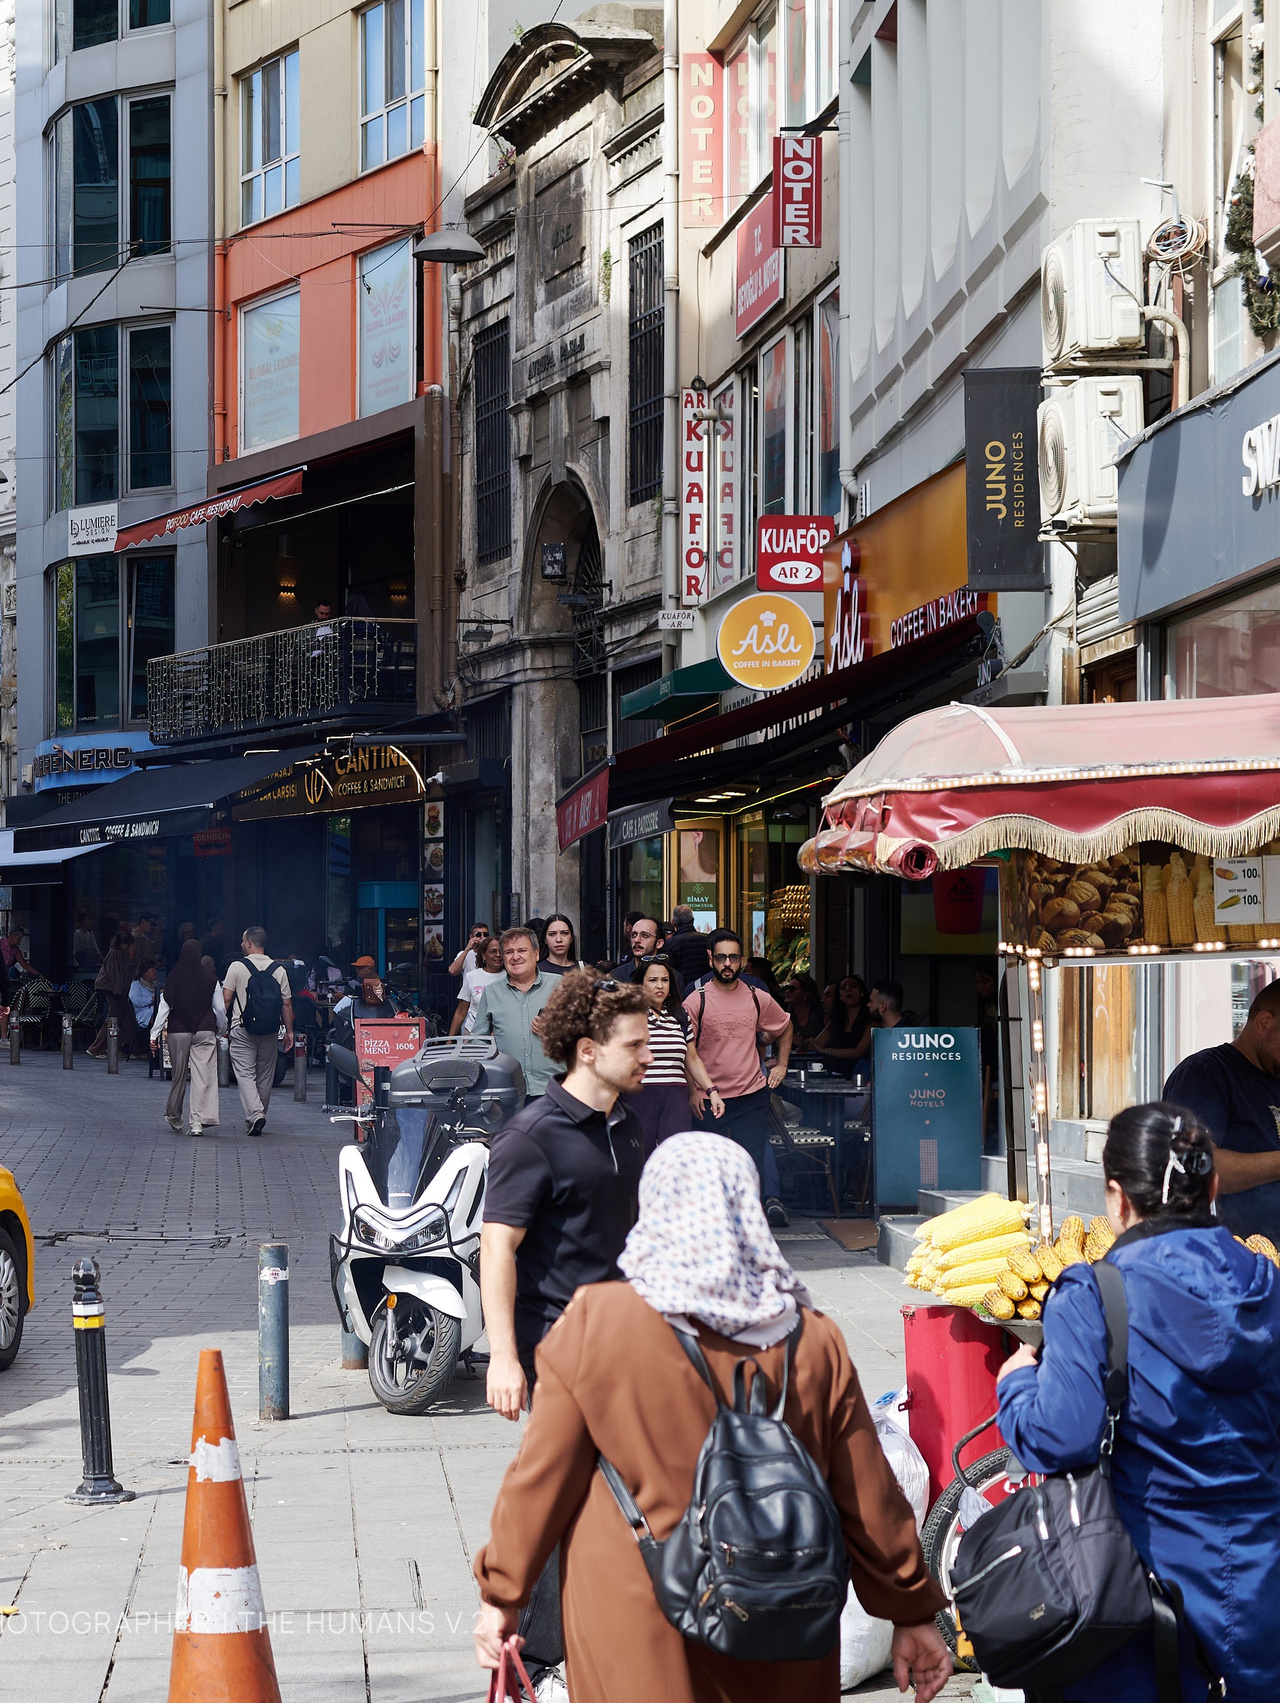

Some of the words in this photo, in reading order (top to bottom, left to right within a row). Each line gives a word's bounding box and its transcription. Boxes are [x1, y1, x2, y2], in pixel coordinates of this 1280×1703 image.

[690, 62, 716, 218] NOTER
[783, 138, 813, 246] NOTER
[763, 249, 780, 291] NOTER
[528, 351, 557, 381] AVRUPA
[684, 392, 707, 409] AR
[984, 440, 1008, 520] JUNO
[1013, 431, 1025, 528] RESIDENCES
[685, 420, 704, 597] KUAFÖR
[80, 515, 116, 531] LUMIERE
[86, 527, 111, 536] DESIGN
[777, 566, 799, 579] AR
[805, 566, 813, 579] 2
[661, 611, 692, 621] KUAFÖR
[890, 606, 925, 650] COFFEE
[927, 600, 938, 635] IN
[939, 588, 980, 628] BAKERY
[733, 660, 760, 669] COFFEE
[762, 660, 771, 668] IN
[772, 659, 801, 668] BAKERY
[337, 780, 362, 797] COFFEE
[369, 774, 407, 792] SANDWICH
[130, 820, 160, 838] SANDWICH
[1242, 868, 1258, 879] 100
[686, 895, 710, 903] BİMAY
[1242, 894, 1258, 905] 100
[364, 1038, 390, 1047] PİZZA
[897, 1033, 956, 1049] JUNO
[891, 1052, 962, 1061] RESIDENCES
[909, 1089, 947, 1099] JUNO
[910, 1100, 945, 1108] HOTELS
